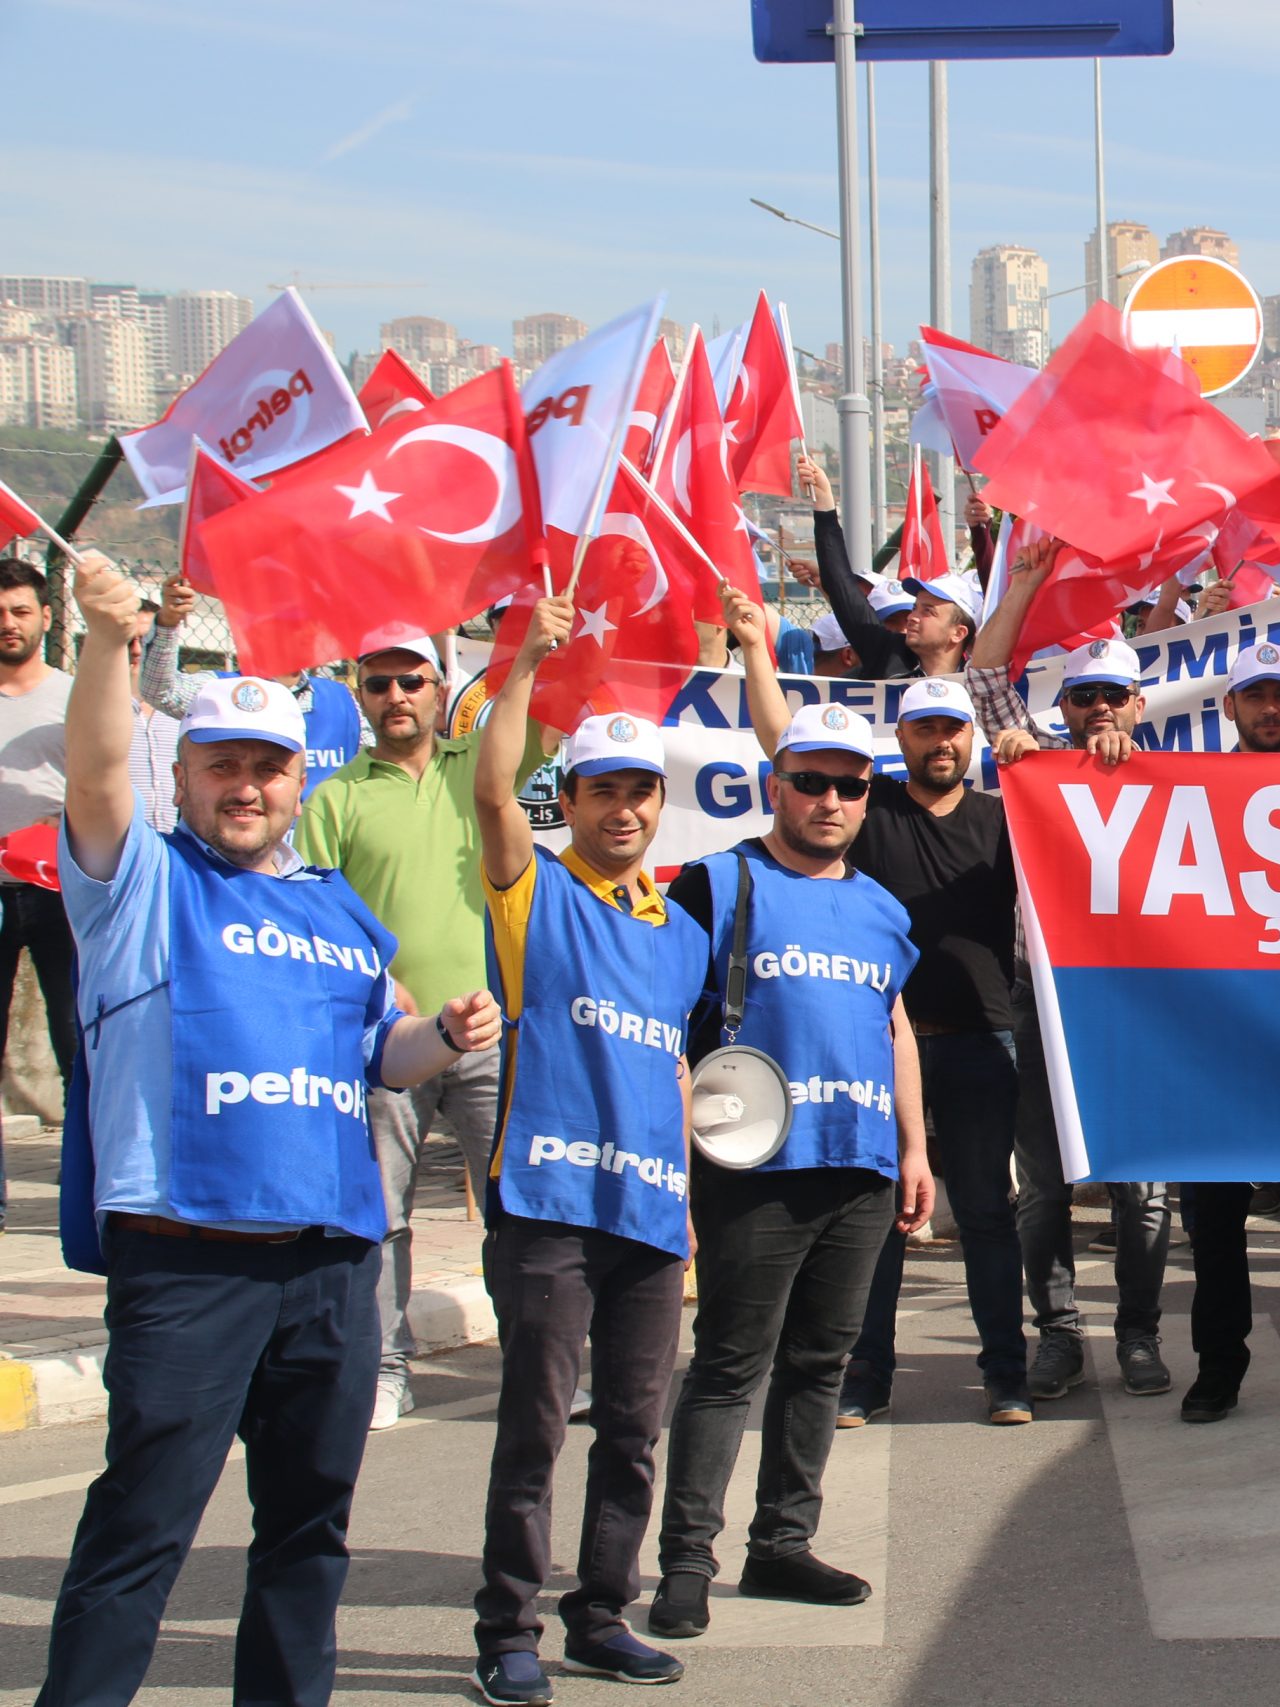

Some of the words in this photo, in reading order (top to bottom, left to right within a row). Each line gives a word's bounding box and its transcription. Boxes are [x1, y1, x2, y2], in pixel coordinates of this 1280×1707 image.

[461, 685, 488, 718] PETRO
[305, 746, 345, 768] EVLİ
[221, 918, 382, 981] GÖREVLİ
[753, 944, 891, 993] GÖREVLİ
[570, 996, 684, 1059] GÖREVL
[789, 1075, 892, 1121] etrol-iş
[528, 1134, 687, 1203] petrol-iş
